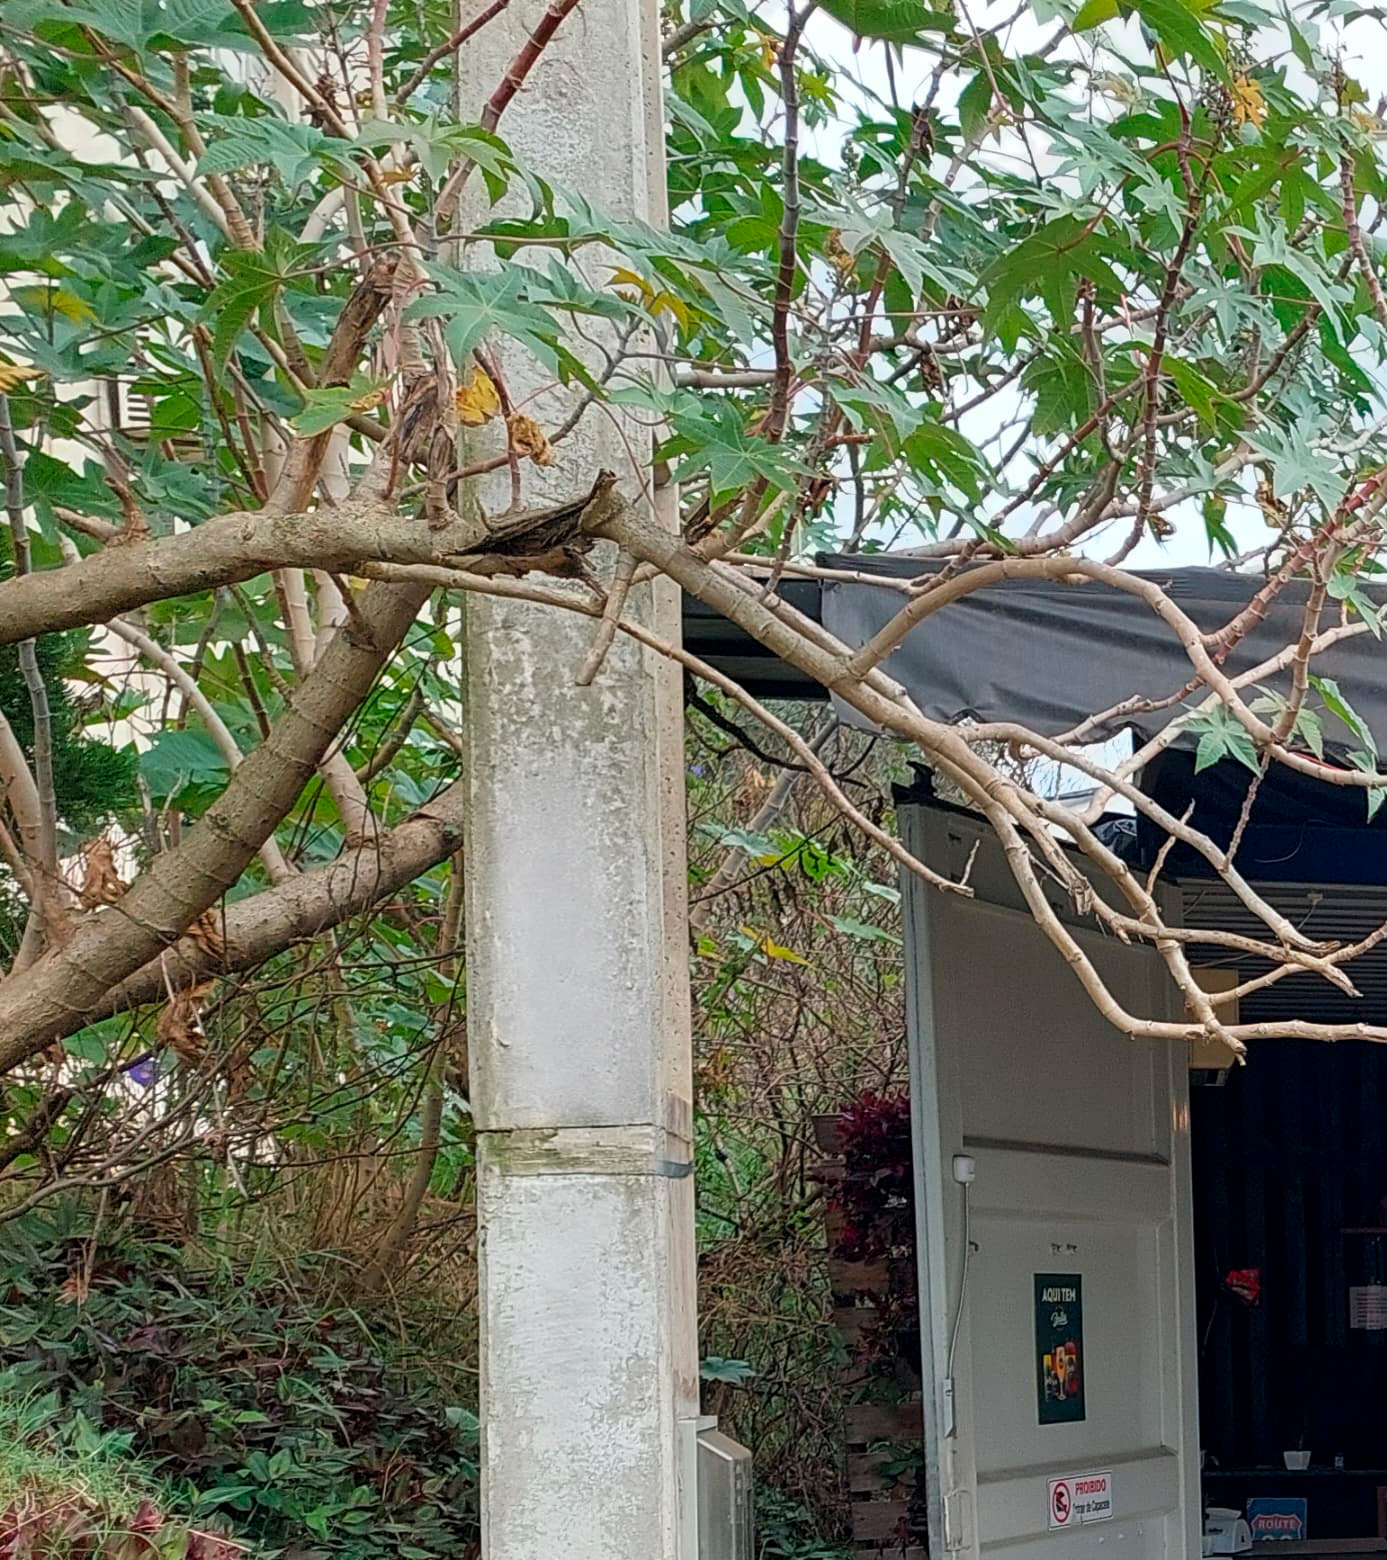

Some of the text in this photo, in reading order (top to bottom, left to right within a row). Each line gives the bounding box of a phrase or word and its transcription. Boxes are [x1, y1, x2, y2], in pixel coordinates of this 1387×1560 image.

[1041, 1287, 1077, 1303] AQUI TEM
[1075, 1478, 1106, 1496] PROIBIDO
[1258, 1518, 1296, 1529] ROUTE
